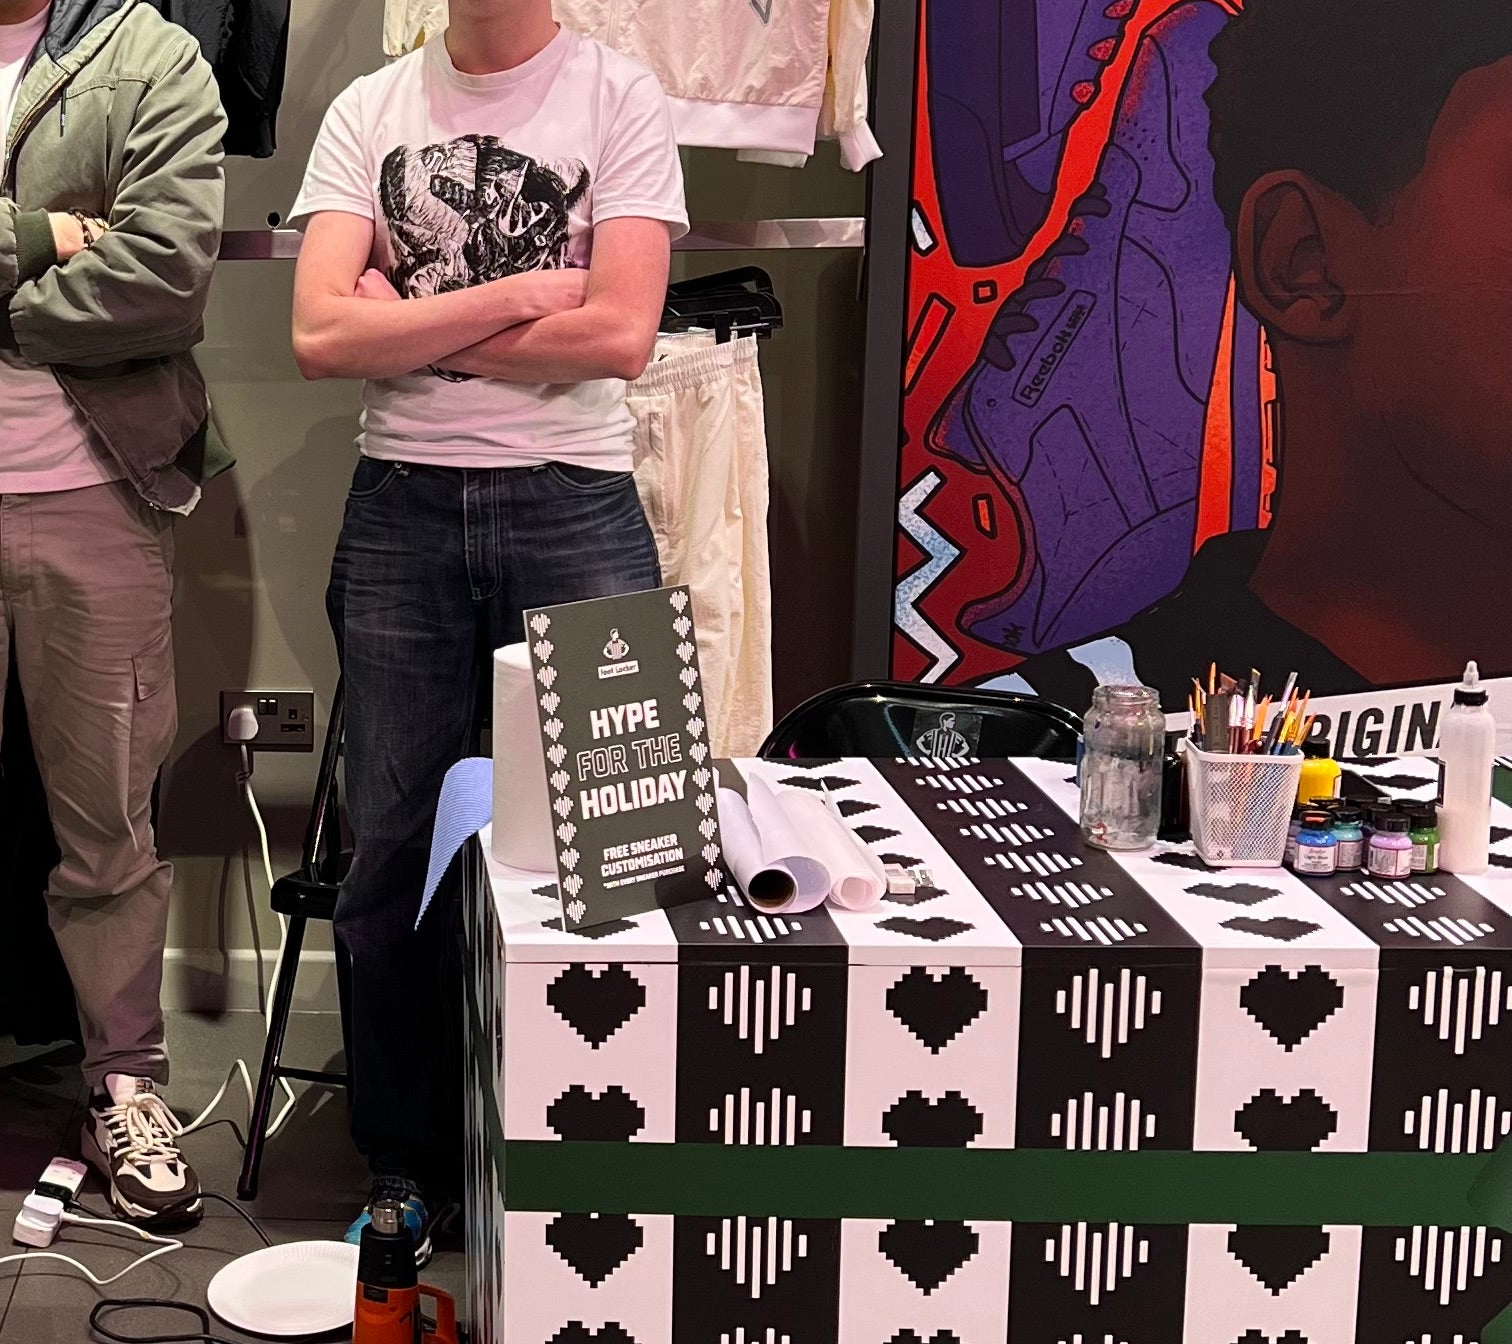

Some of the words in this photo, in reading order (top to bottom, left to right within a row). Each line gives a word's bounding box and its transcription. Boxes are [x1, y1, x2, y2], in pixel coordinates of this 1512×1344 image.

[589, 699, 660, 739] HYPE
[576, 744, 629, 781] FOR
[631, 733, 683, 769] THE
[579, 769, 688, 820] HOLIDAY
[600, 847, 684, 877] CUSTOMISATION
[603, 844, 630, 861] FREE
[630, 833, 679, 856] SNEAKER
